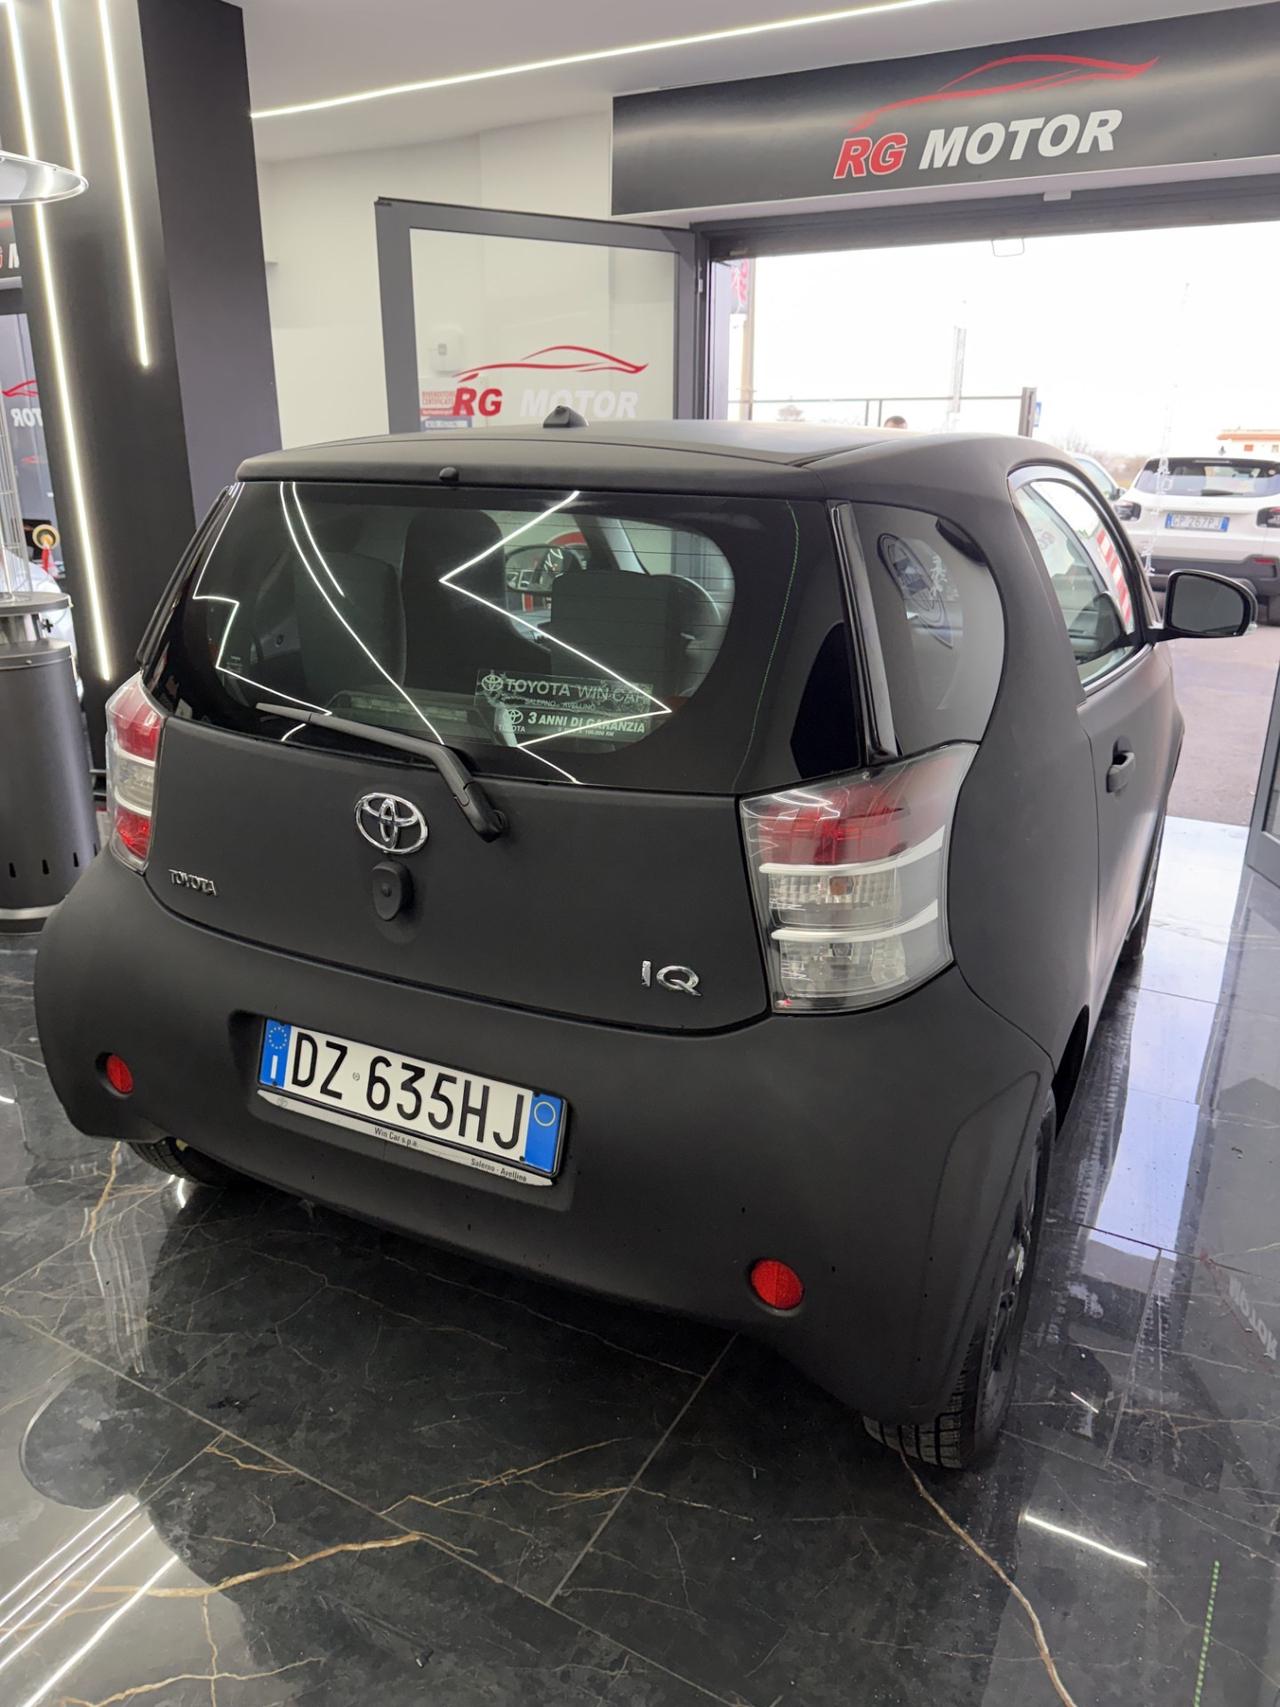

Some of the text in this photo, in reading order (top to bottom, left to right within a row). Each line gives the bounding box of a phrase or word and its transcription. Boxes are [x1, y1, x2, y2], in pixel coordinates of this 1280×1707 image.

[833, 109, 1123, 179] RG MOTOR
[453, 387, 640, 418] RG MOTOR
[506, 678, 571, 697] TOYOTA
[577, 685, 609, 701] WIN
[528, 711, 537, 724] 3
[538, 714, 568, 726] ANNI
[570, 717, 583, 727] DI
[585, 718, 645, 733] GARANZIA
[168, 869, 217, 896] TOYOTA
[292, 1032, 524, 1150] DZ 635HJ
[374, 1127, 389, 1138] Win
[389, 1132, 401, 1142] Car
[471, 1158, 495, 1172] Salerno
[500, 1167, 527, 1182] Avellino
